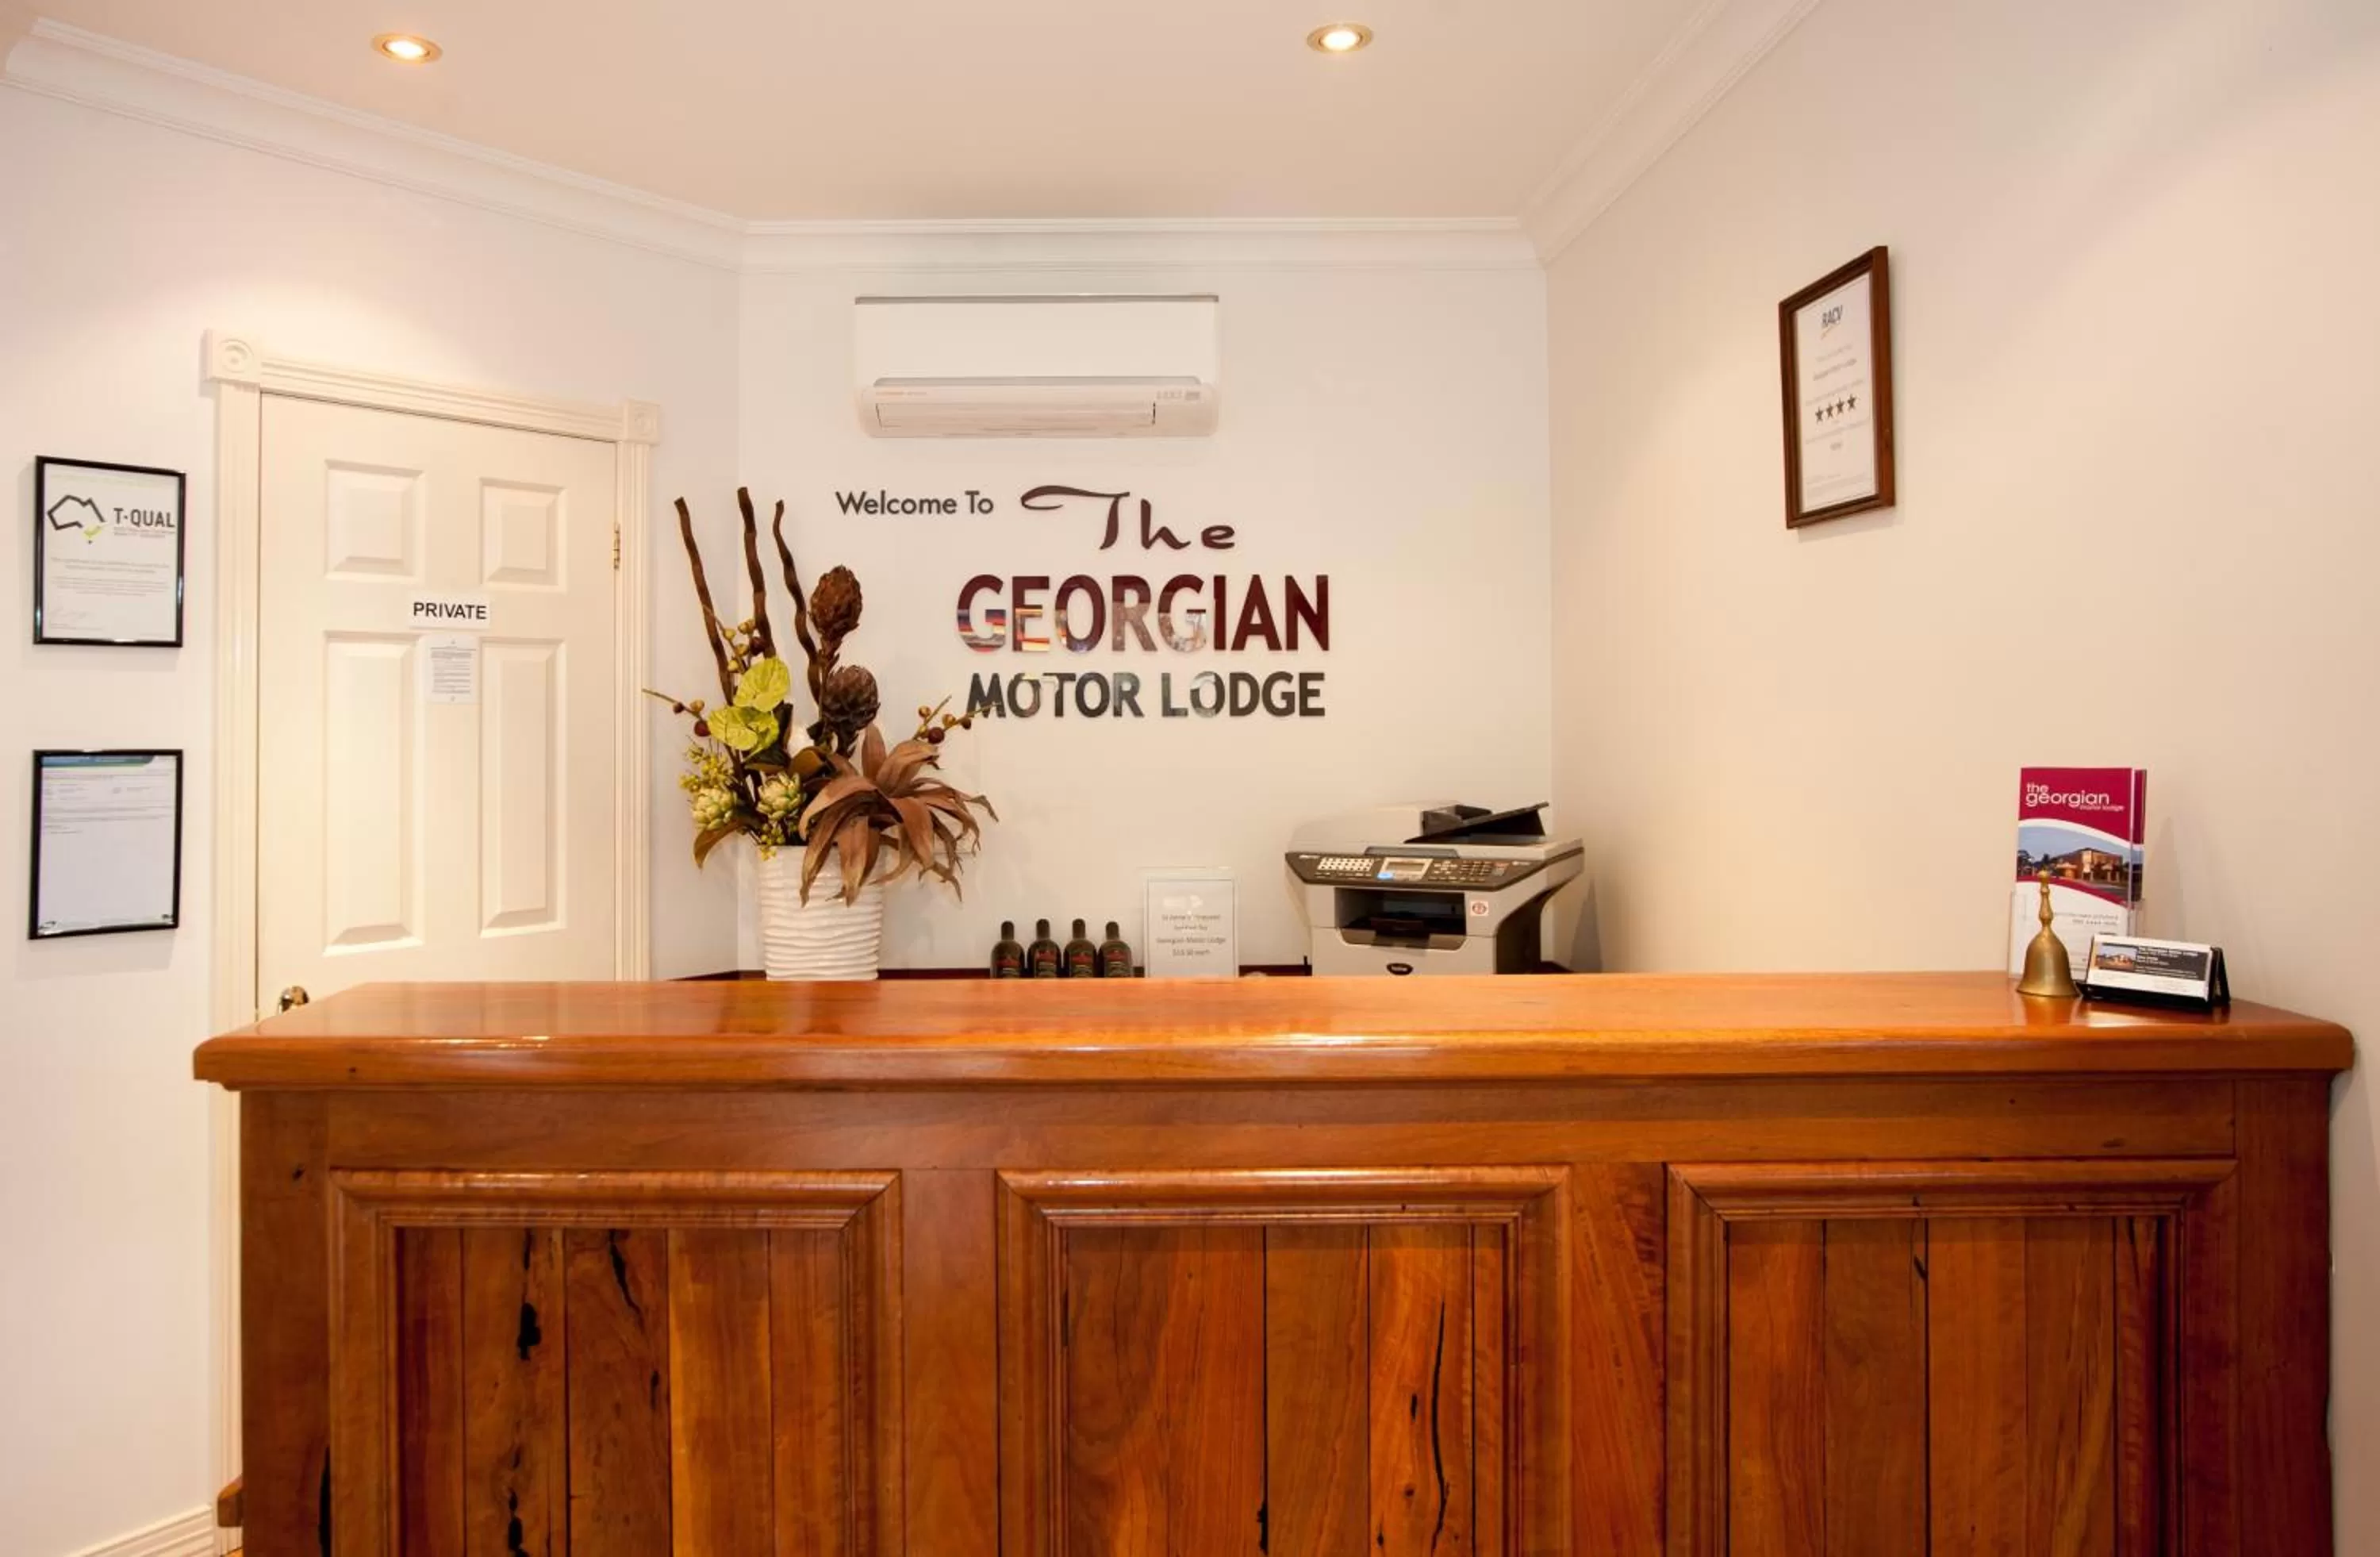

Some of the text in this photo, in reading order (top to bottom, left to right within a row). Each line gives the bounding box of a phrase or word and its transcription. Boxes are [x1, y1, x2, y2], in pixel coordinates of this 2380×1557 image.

[835, 485, 1235, 549] Welcome To The
[413, 602, 487, 621] PRIVATE
[956, 573, 1330, 654] GEORGIAN
[965, 671, 1326, 718] MOTOR LODGE
[2025, 790, 2110, 808] georgian
[2026, 782, 2049, 793] the
